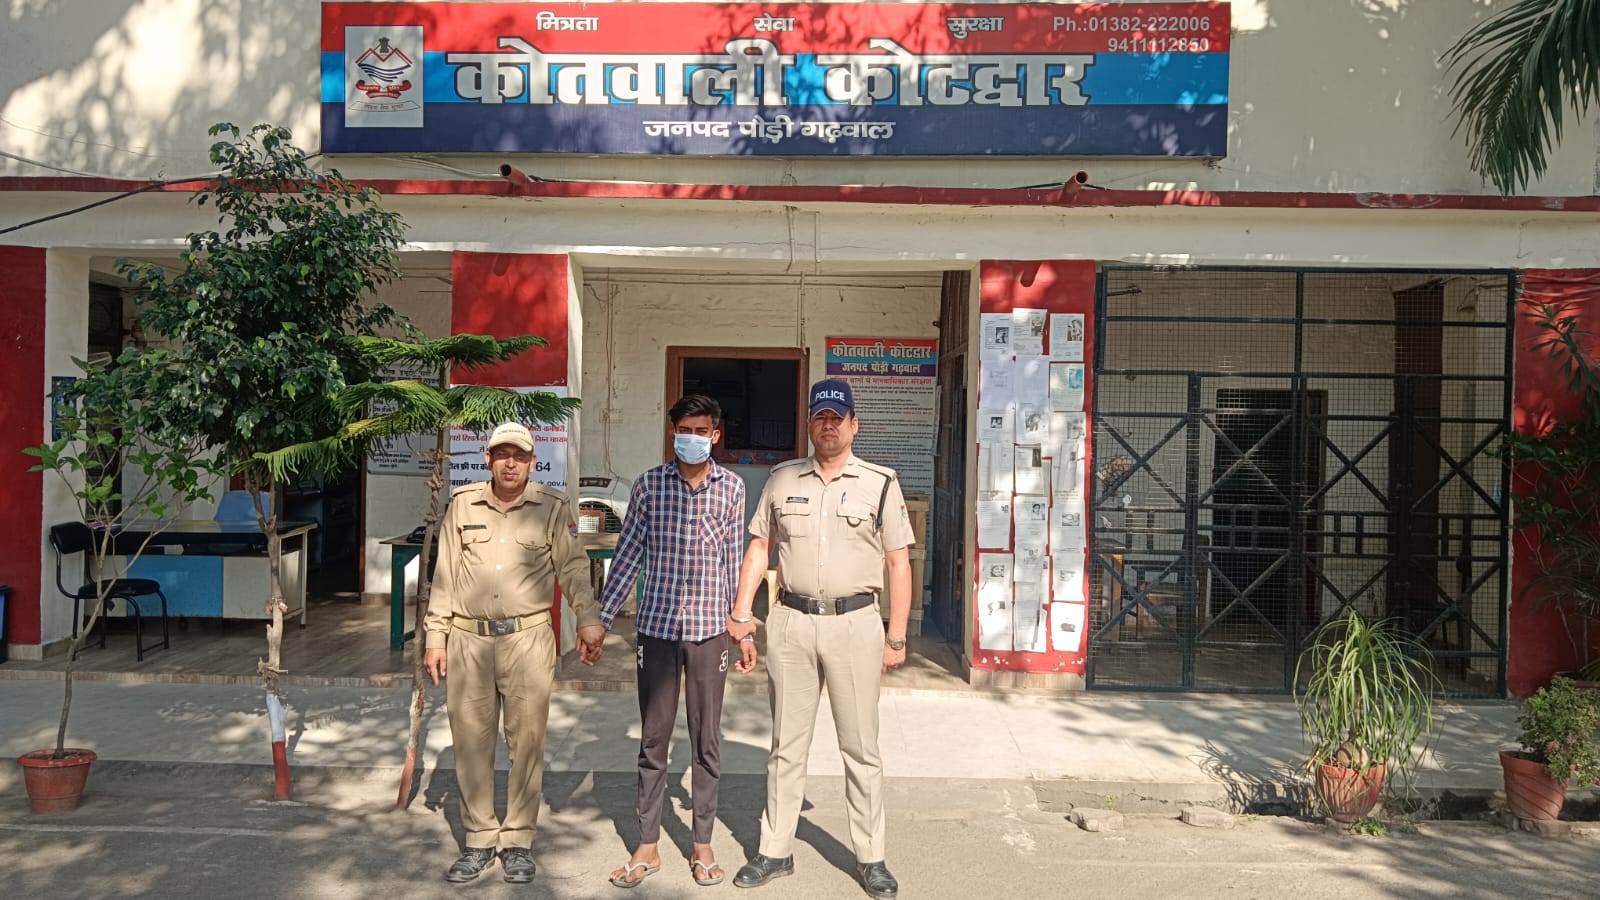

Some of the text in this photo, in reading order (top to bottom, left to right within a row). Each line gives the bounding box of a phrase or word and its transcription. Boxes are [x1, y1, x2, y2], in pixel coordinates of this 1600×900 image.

[536, 11, 1005, 39] मित्रता सेवा सुरक्षा
[1108, 37, 1210, 52] 9411112850
[447, 37, 1096, 107] कोतवाली कोटद्वार
[642, 120, 732, 138] जनपद
[800, 121, 897, 144] गढ़वाल
[832, 341, 885, 358] कोतवाली
[841, 362, 868, 373] जनपद
[815, 389, 846, 401] POLICE
[535, 461, 552, 473] 64
